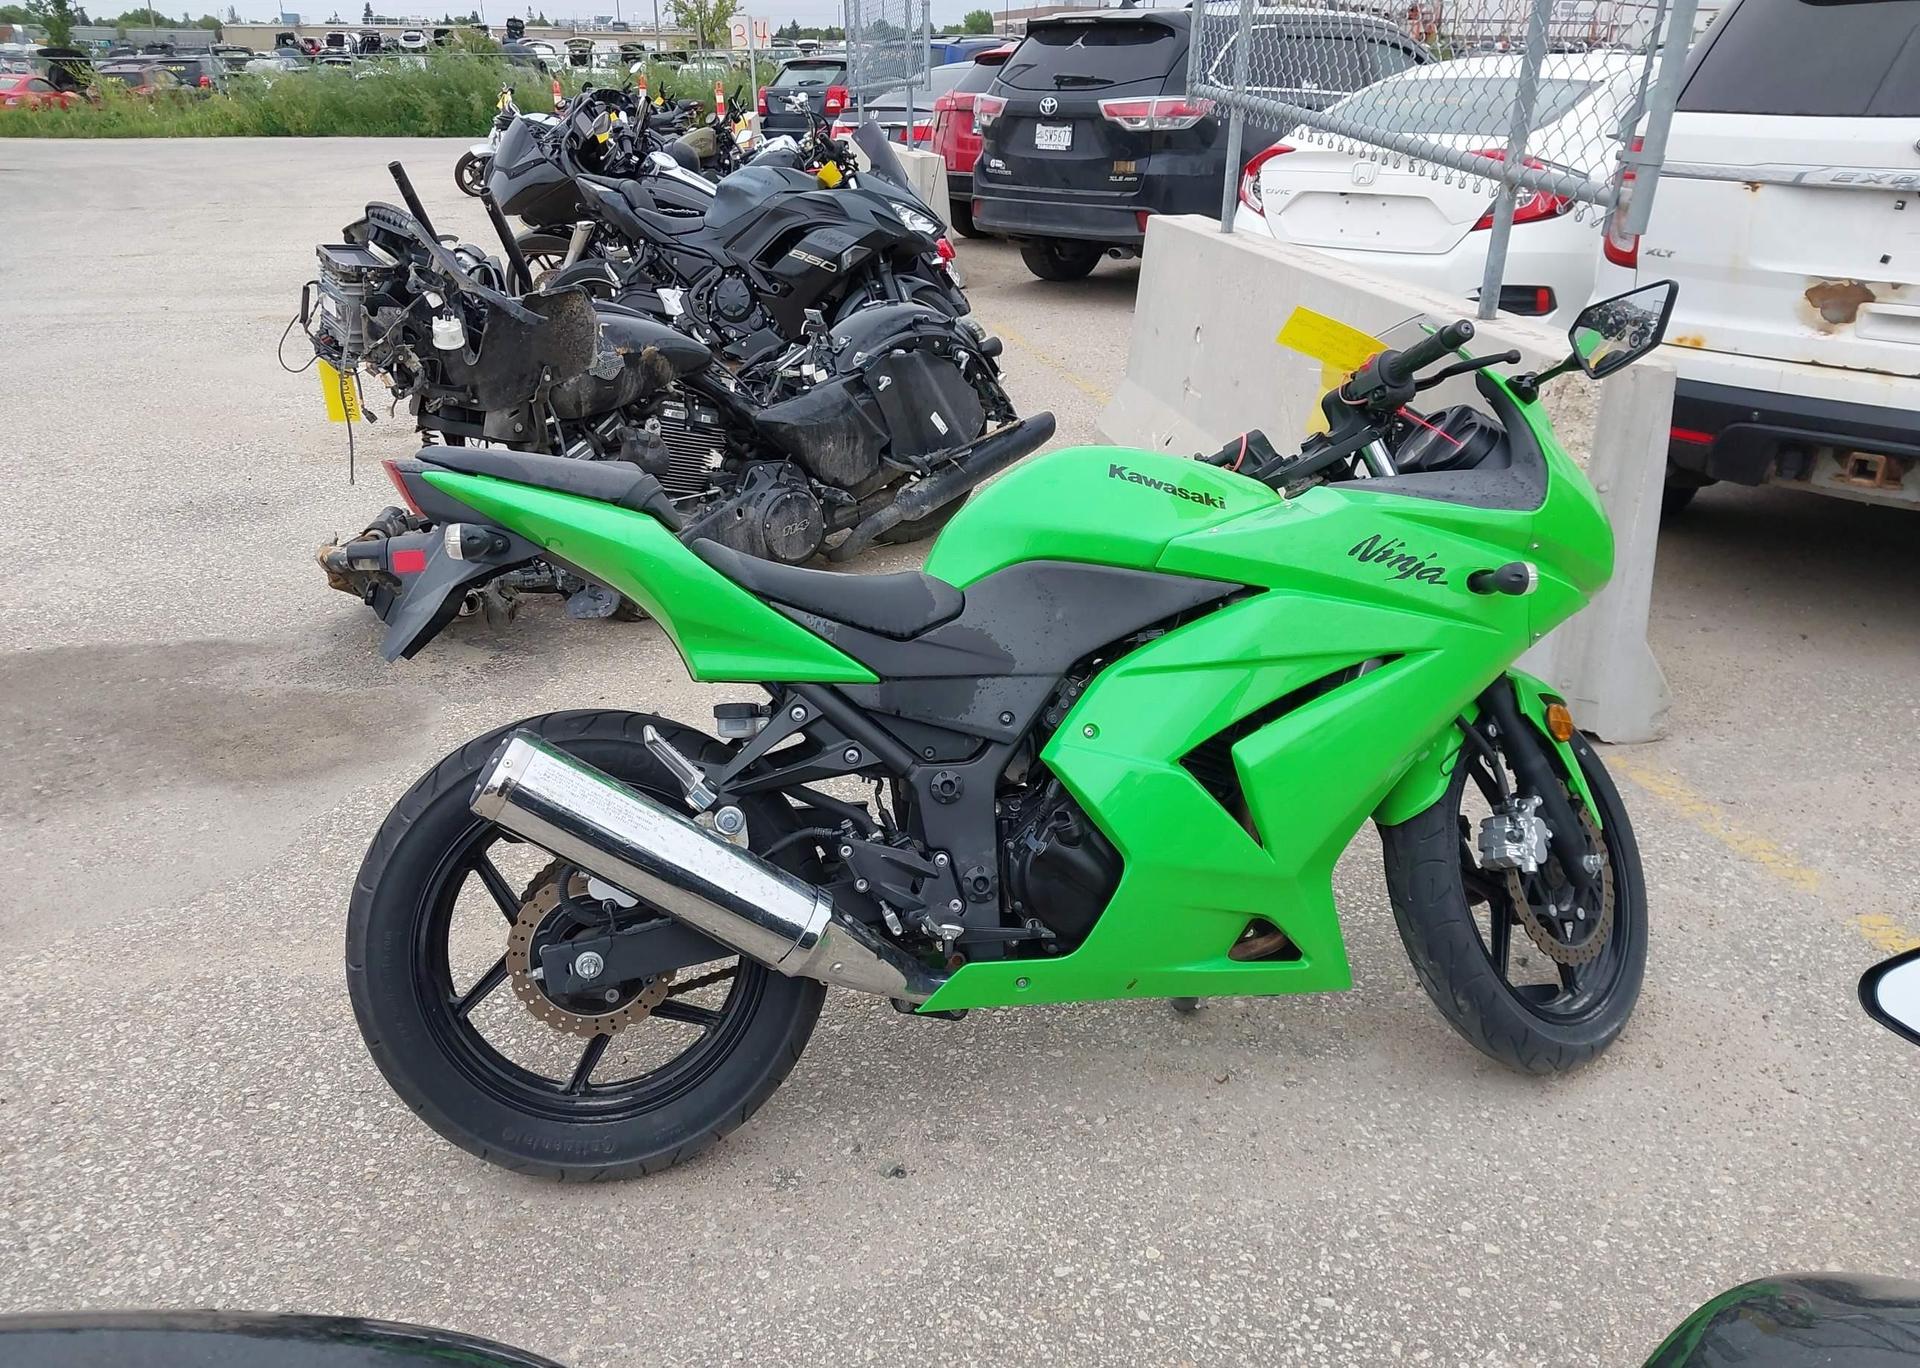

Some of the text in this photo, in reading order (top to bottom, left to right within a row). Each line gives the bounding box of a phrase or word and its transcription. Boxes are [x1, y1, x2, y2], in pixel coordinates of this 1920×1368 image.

[788, 249, 837, 273] 650
[1645, 248, 1676, 259] XLT
[1108, 463, 1226, 510] Kawasaki
[1347, 534, 1449, 585] Ninja
